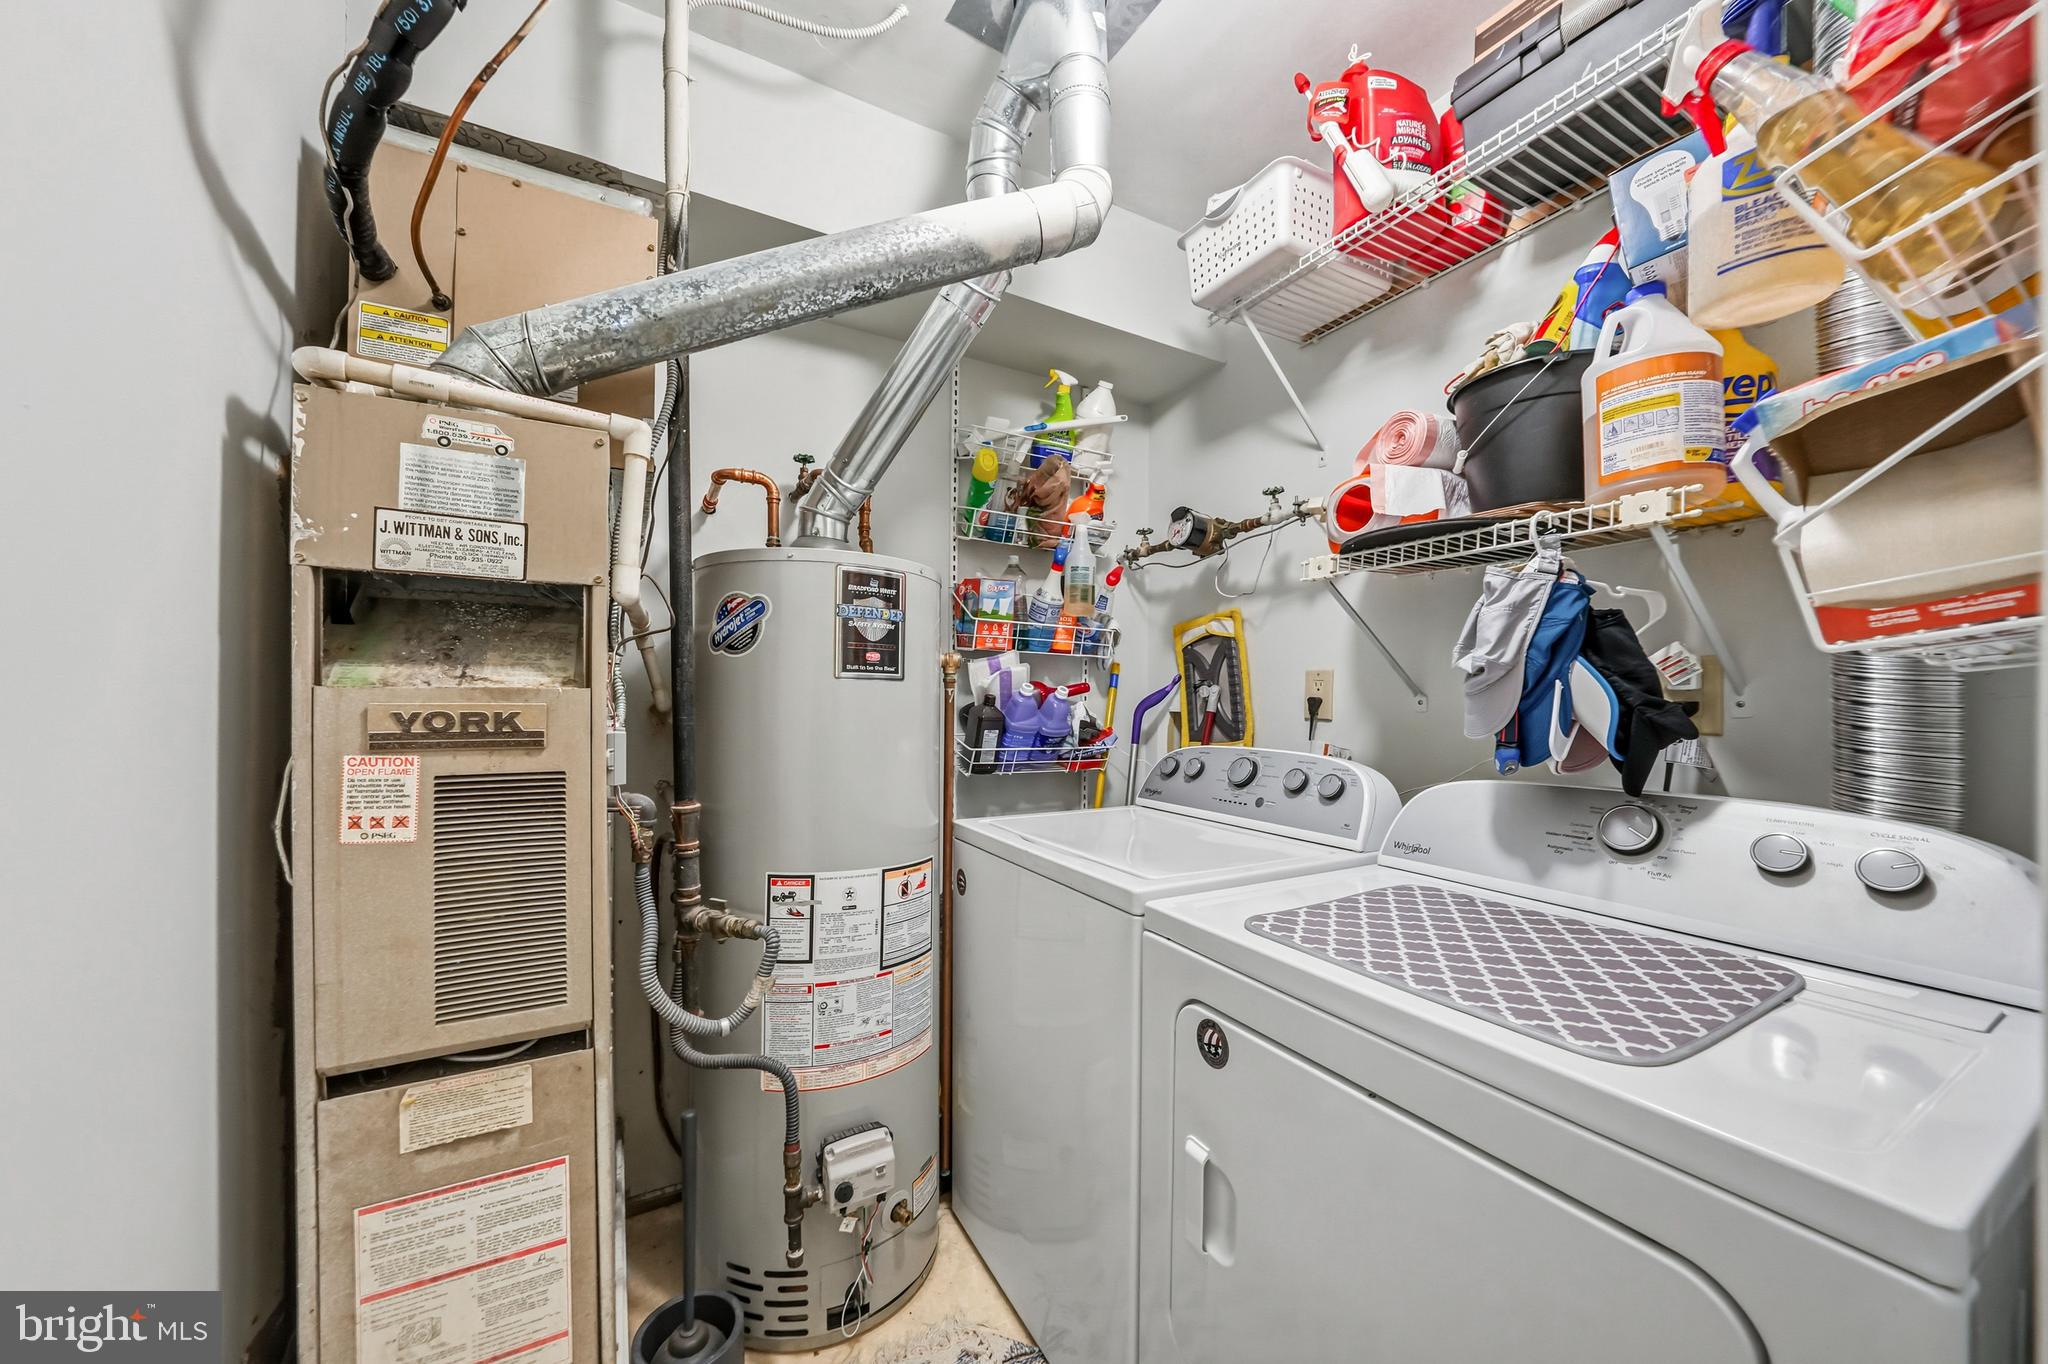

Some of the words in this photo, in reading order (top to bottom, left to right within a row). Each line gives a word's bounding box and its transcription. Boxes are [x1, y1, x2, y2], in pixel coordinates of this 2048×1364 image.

[1392, 136, 1431, 150] ADVANCED
[1735, 192, 1782, 215] BLEAC
[394, 312, 429, 323] CAUTION
[389, 336, 432, 348] ATTENTION
[380, 520, 391, 534] J.
[394, 520, 450, 539] WITTMAN
[455, 527, 463, 540] &
[468, 528, 501, 545] SONS,
[504, 533, 523, 546] Inc.
[838, 604, 904, 622] DEFENDER
[715, 613, 745, 644] Hydrojet
[391, 711, 524, 733] YORK
[347, 757, 414, 767] CAUTION
[1870, 832, 1897, 840] CYCLE
[1899, 835, 1930, 843] SIGNAL
[1394, 841, 1431, 854] Whirlpool
